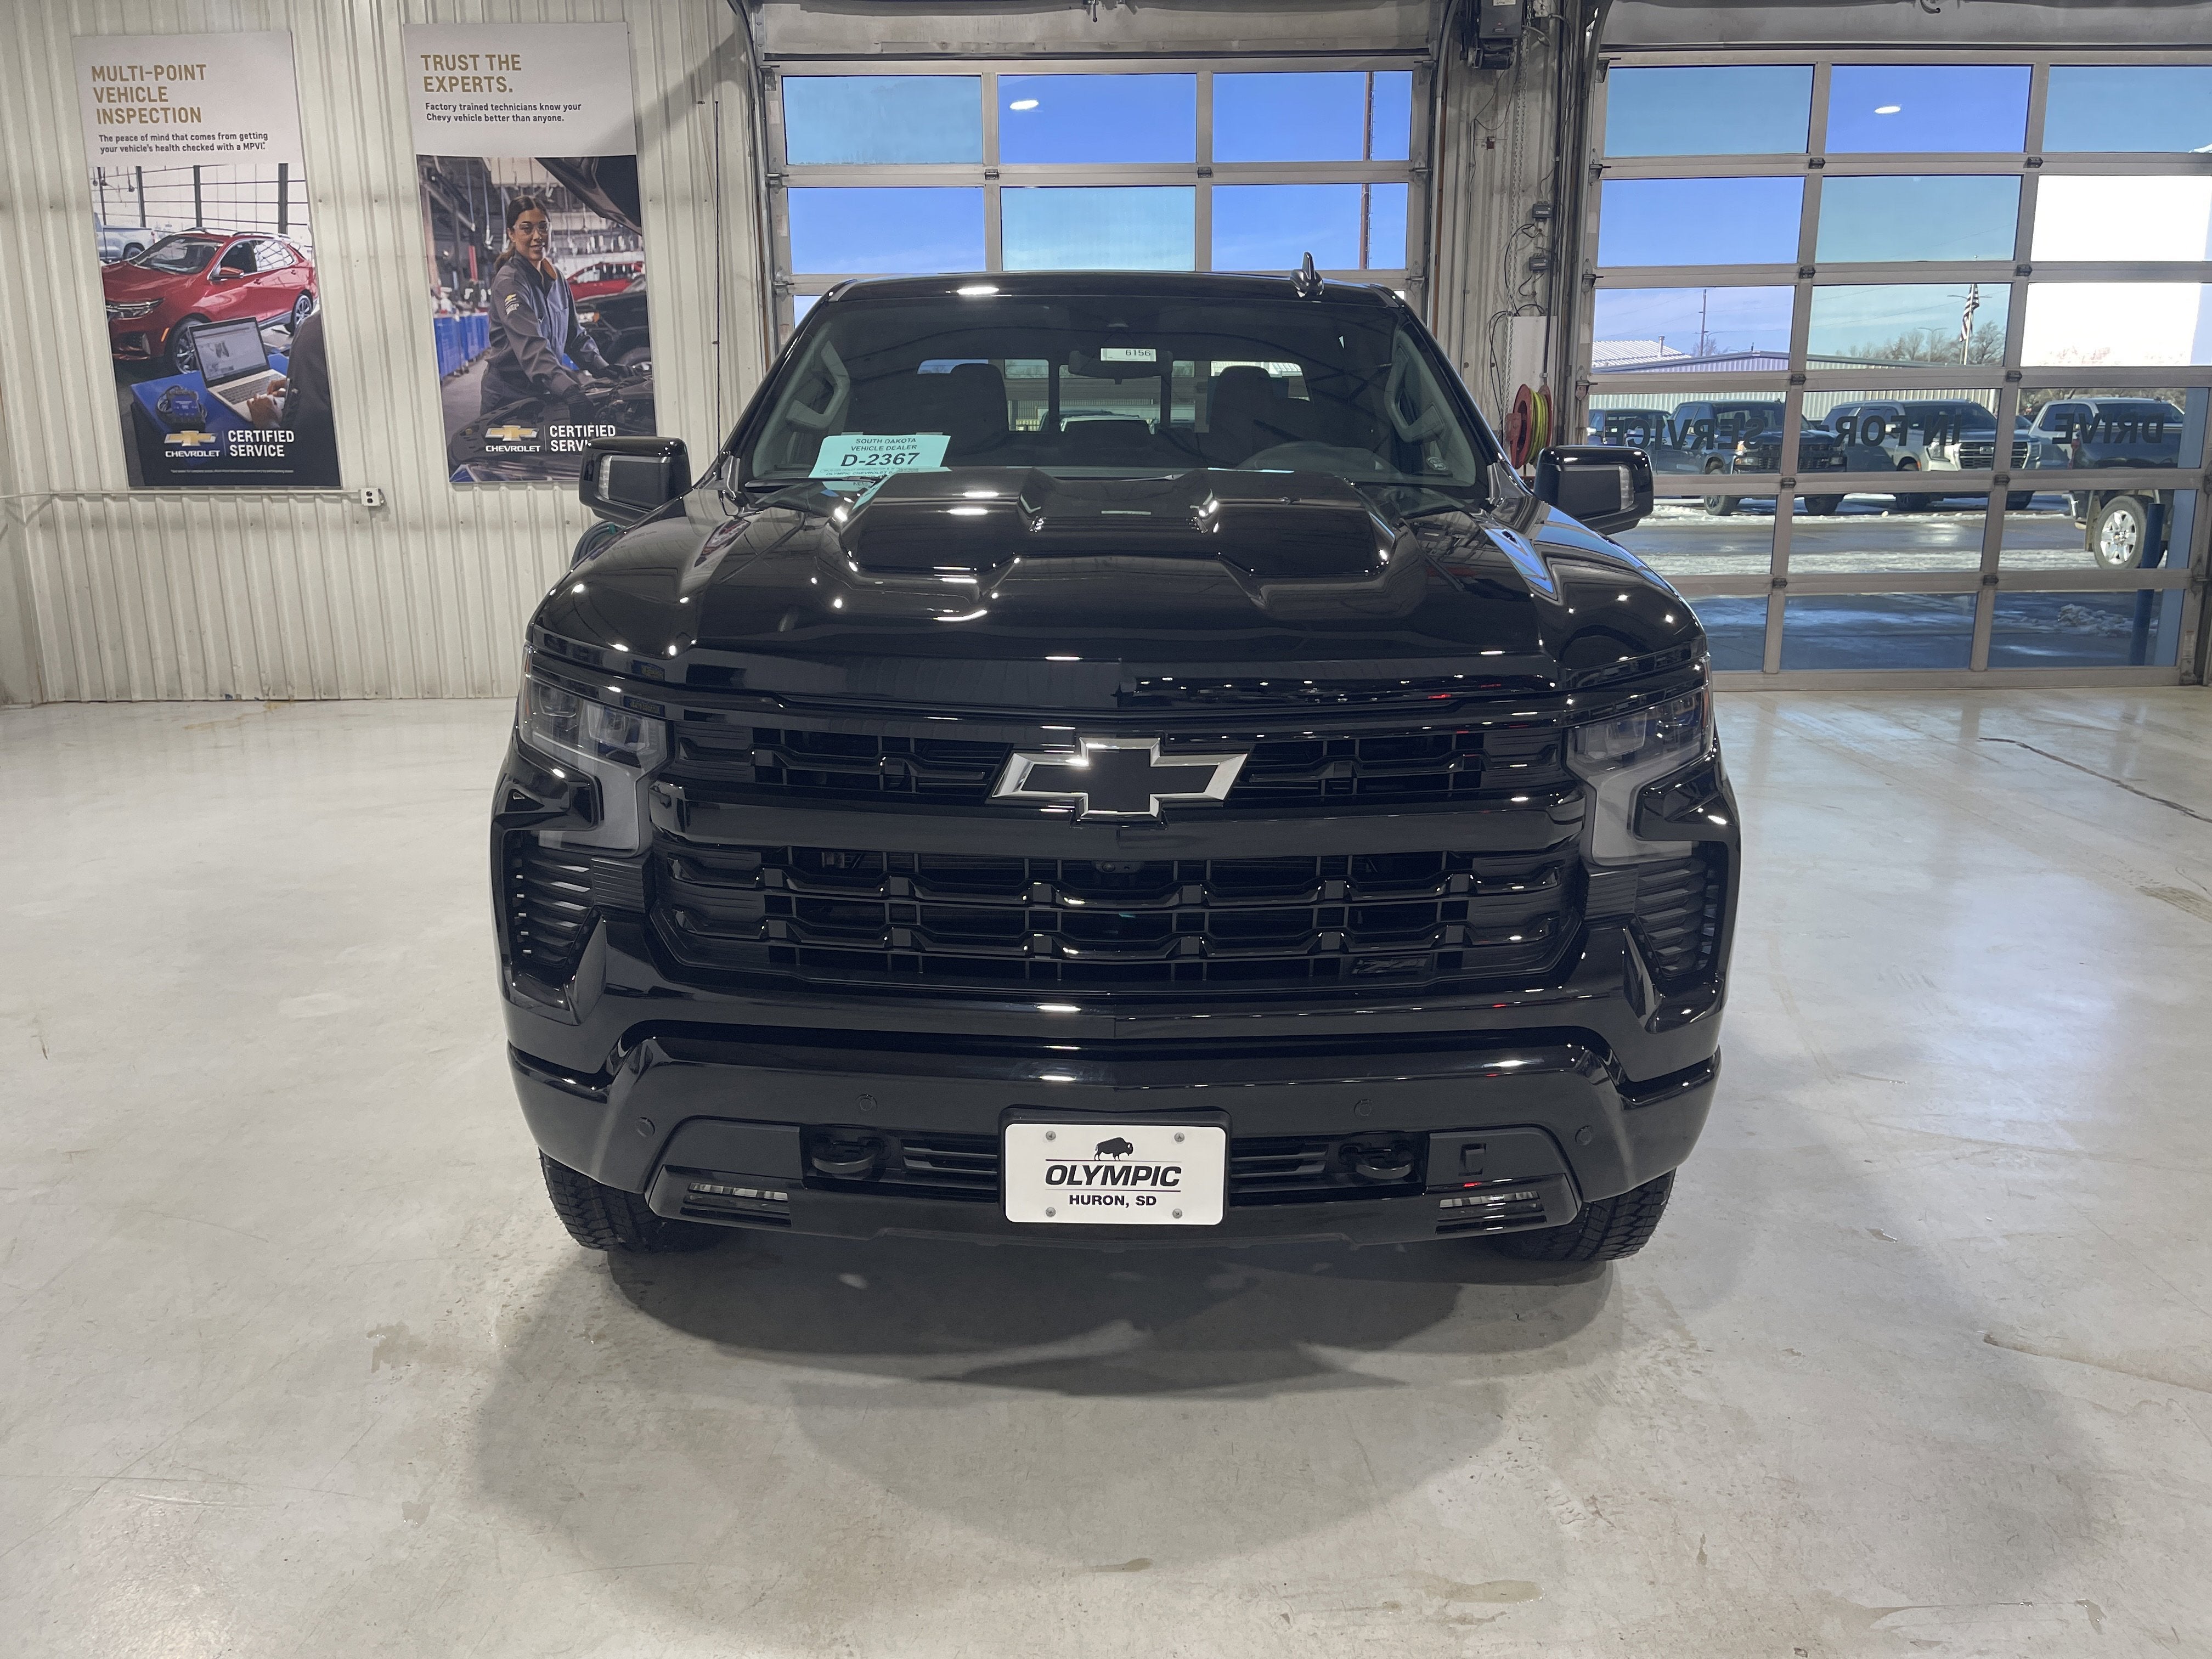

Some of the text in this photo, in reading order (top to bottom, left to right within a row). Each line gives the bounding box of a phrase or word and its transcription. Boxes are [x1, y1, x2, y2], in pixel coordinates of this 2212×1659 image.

[421, 54, 522, 71] TRUST THE
[92, 64, 207, 82] MULTI-POINT
[423, 76, 514, 93] EXPERTS.
[93, 86, 169, 103] VEHICLE
[426, 103, 457, 112] Factory
[459, 103, 488, 111] trained
[491, 103, 538, 111] technicians
[563, 103, 582, 112] your
[96, 107, 202, 125] INSPECTION
[427, 113, 565, 123] Chevy vehicle better than anyone.
[116, 135, 138, 144] peace
[140, 133, 148, 142] of
[172, 133, 189, 141] that
[239, 131, 268, 142] getting
[100, 146, 118, 155] your
[120, 144, 153, 153] vehicle's
[155, 143, 180, 151] health
[182, 143, 215, 151] checked
[217, 143, 234, 151] with
[228, 430, 295, 443] CERTIFIED
[549, 425, 616, 437] CERTIFIED
[165, 450, 220, 458] CHEVROLET
[230, 444, 285, 458] SERVICE
[840, 452, 920, 466] D-2367
[1045, 1164, 1182, 1187] OLYMPIC
[1069, 1194, 1156, 1208] HURON, SD
